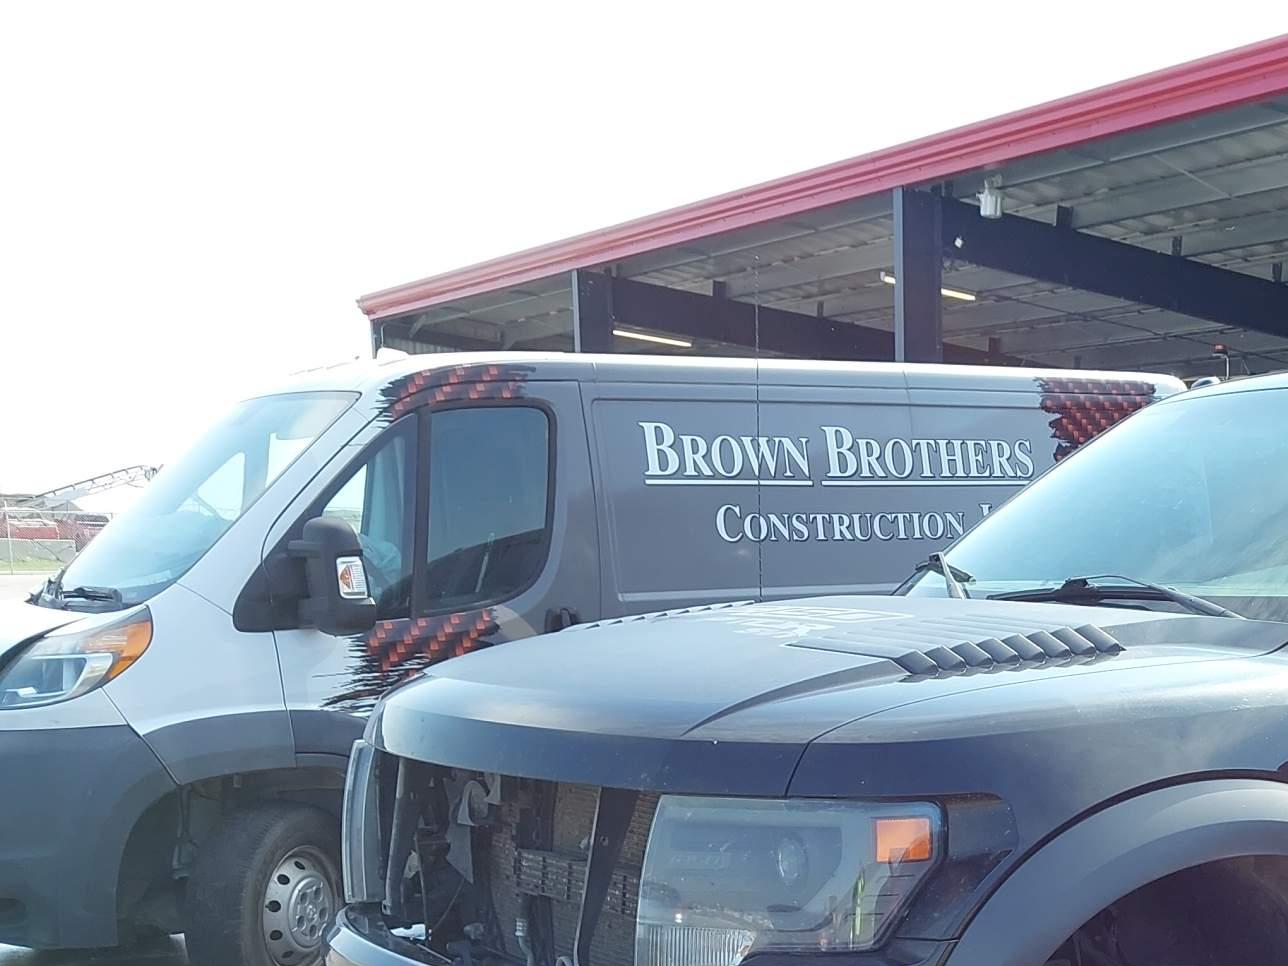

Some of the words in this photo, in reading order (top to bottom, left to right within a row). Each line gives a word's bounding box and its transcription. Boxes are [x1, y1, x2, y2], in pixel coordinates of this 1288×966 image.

[638, 421, 812, 478] BROWN
[820, 426, 1035, 479] BROTHERS
[715, 504, 965, 543] CONSTRUCTION
